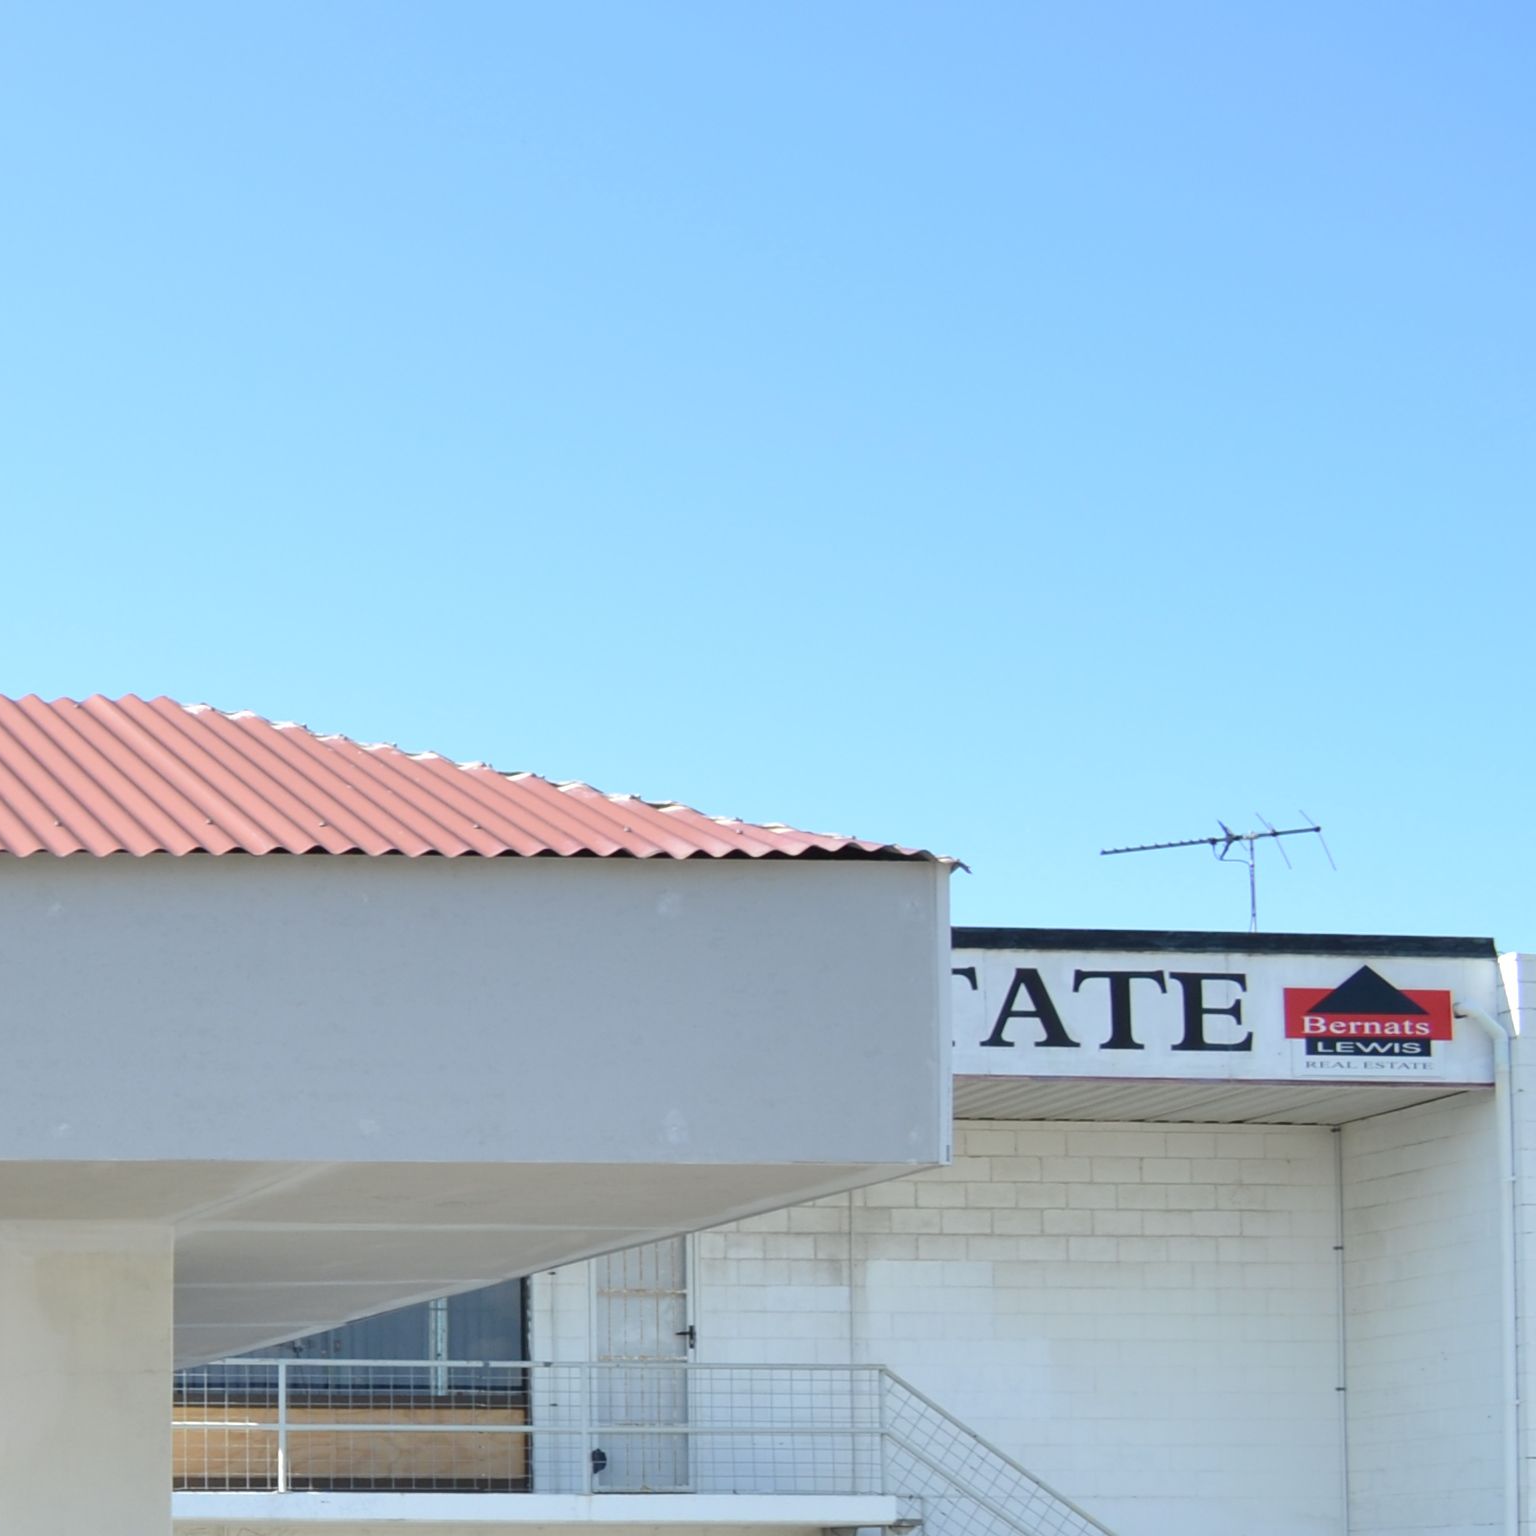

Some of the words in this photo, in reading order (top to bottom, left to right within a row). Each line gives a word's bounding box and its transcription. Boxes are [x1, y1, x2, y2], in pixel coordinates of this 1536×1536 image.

[952, 966, 1253, 1052] ATE
[1302, 1015, 1431, 1036] Bernats
[1316, 1041, 1422, 1054] LEWIS
[1305, 1061, 1357, 1069] REAL
[1363, 1061, 1433, 1071] ESTATE
